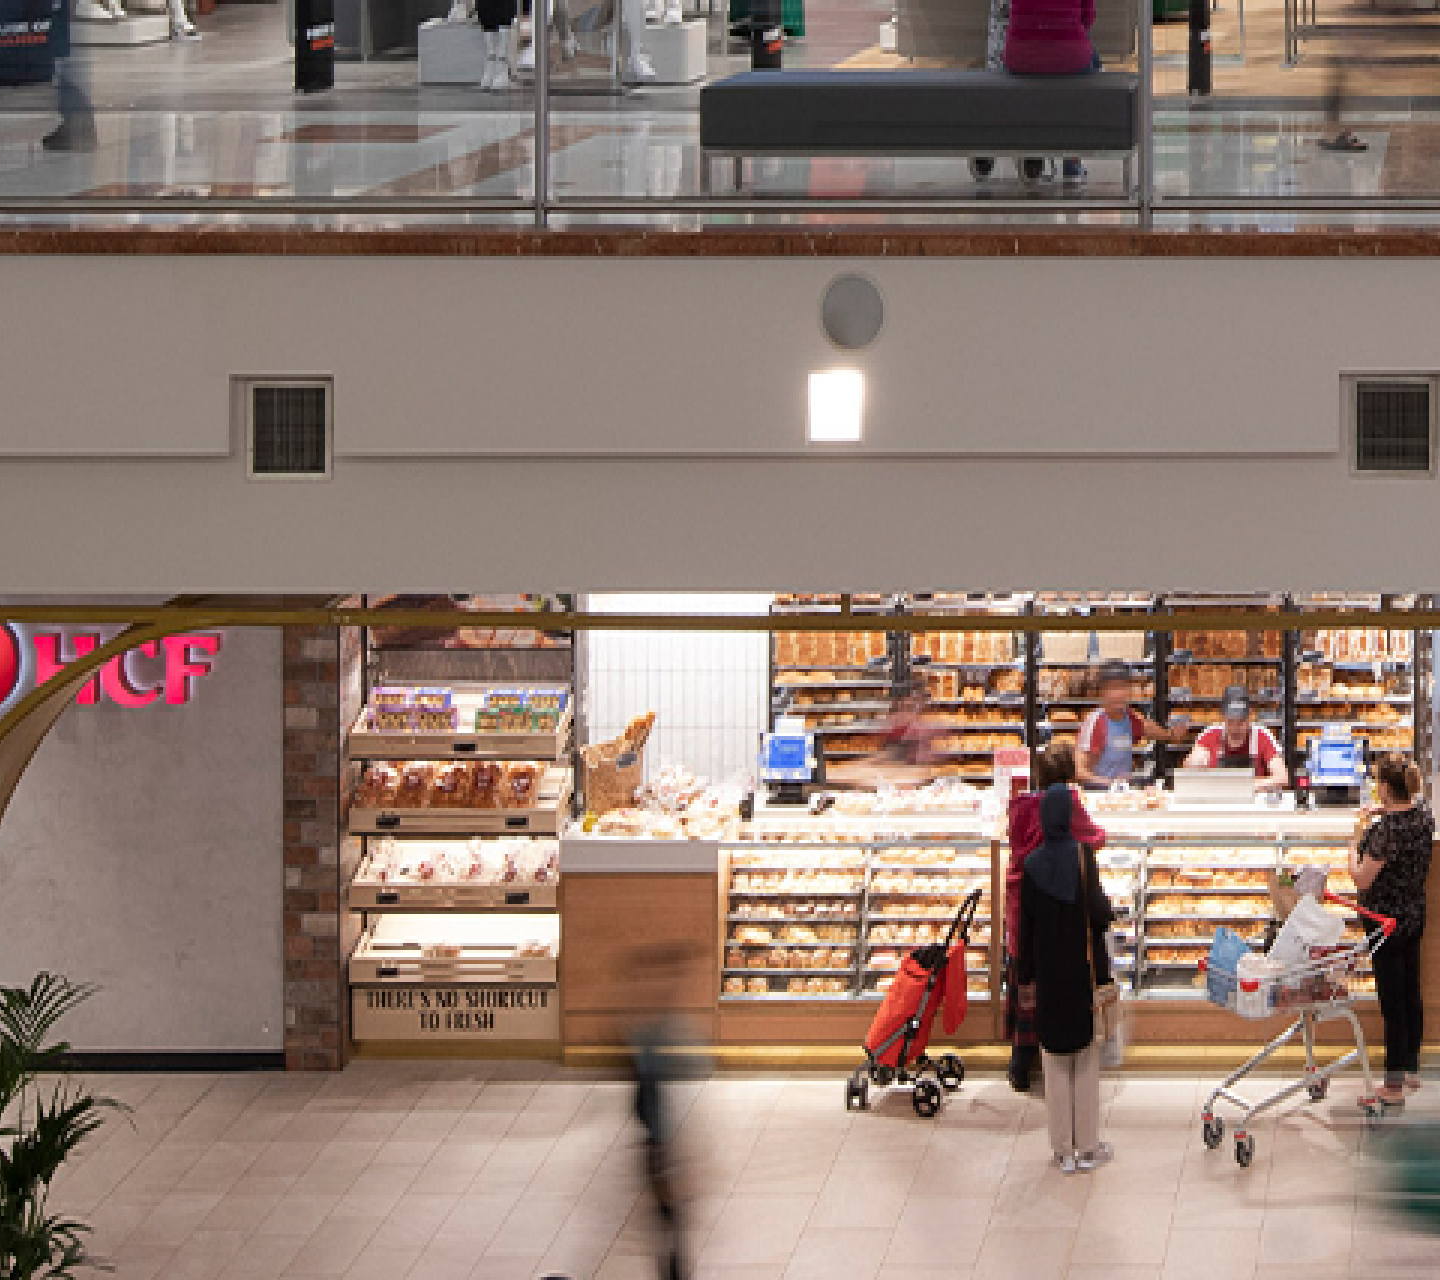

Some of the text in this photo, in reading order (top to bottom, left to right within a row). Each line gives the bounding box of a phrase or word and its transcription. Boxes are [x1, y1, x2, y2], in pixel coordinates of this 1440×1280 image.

[33, 632, 222, 709] HCF
[366, 989, 549, 1009] THERE'S NO SHORTCUT
[418, 1010, 496, 1030] TO FRESH
